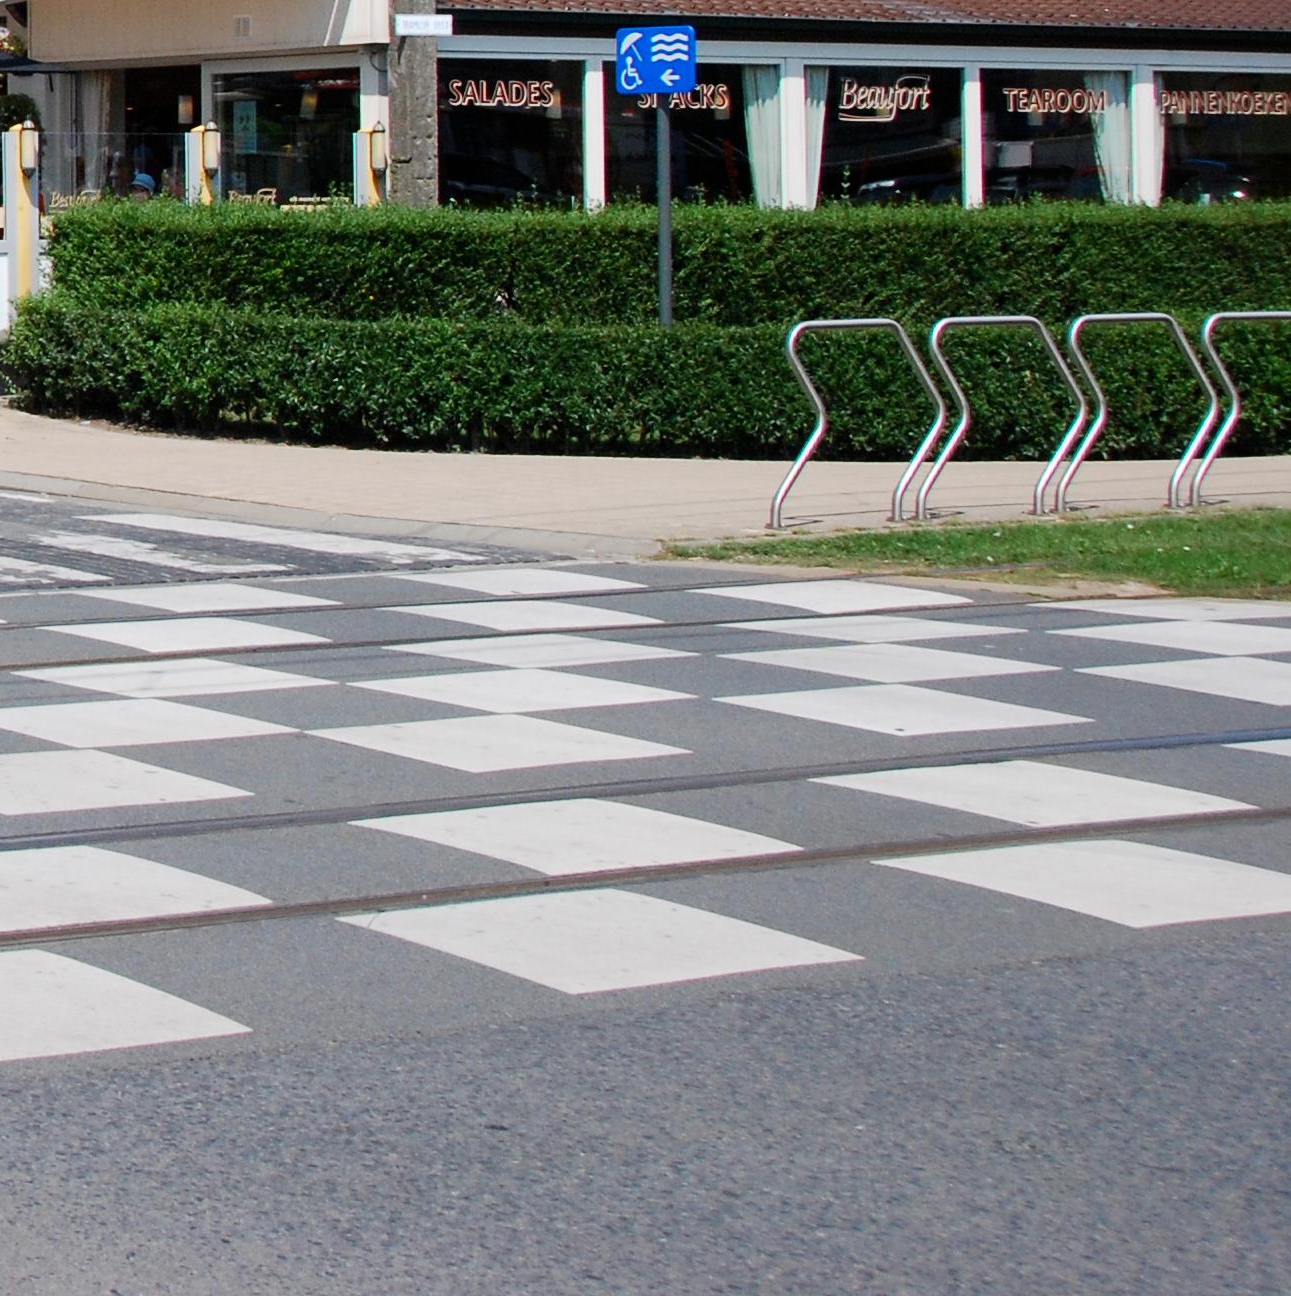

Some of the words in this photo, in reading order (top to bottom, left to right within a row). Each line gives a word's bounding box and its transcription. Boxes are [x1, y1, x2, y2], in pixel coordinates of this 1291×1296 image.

[448, 79, 554, 107] SALADES
[838, 74, 931, 122] Beaufort
[1002, 88, 1108, 113] TEAROOM
